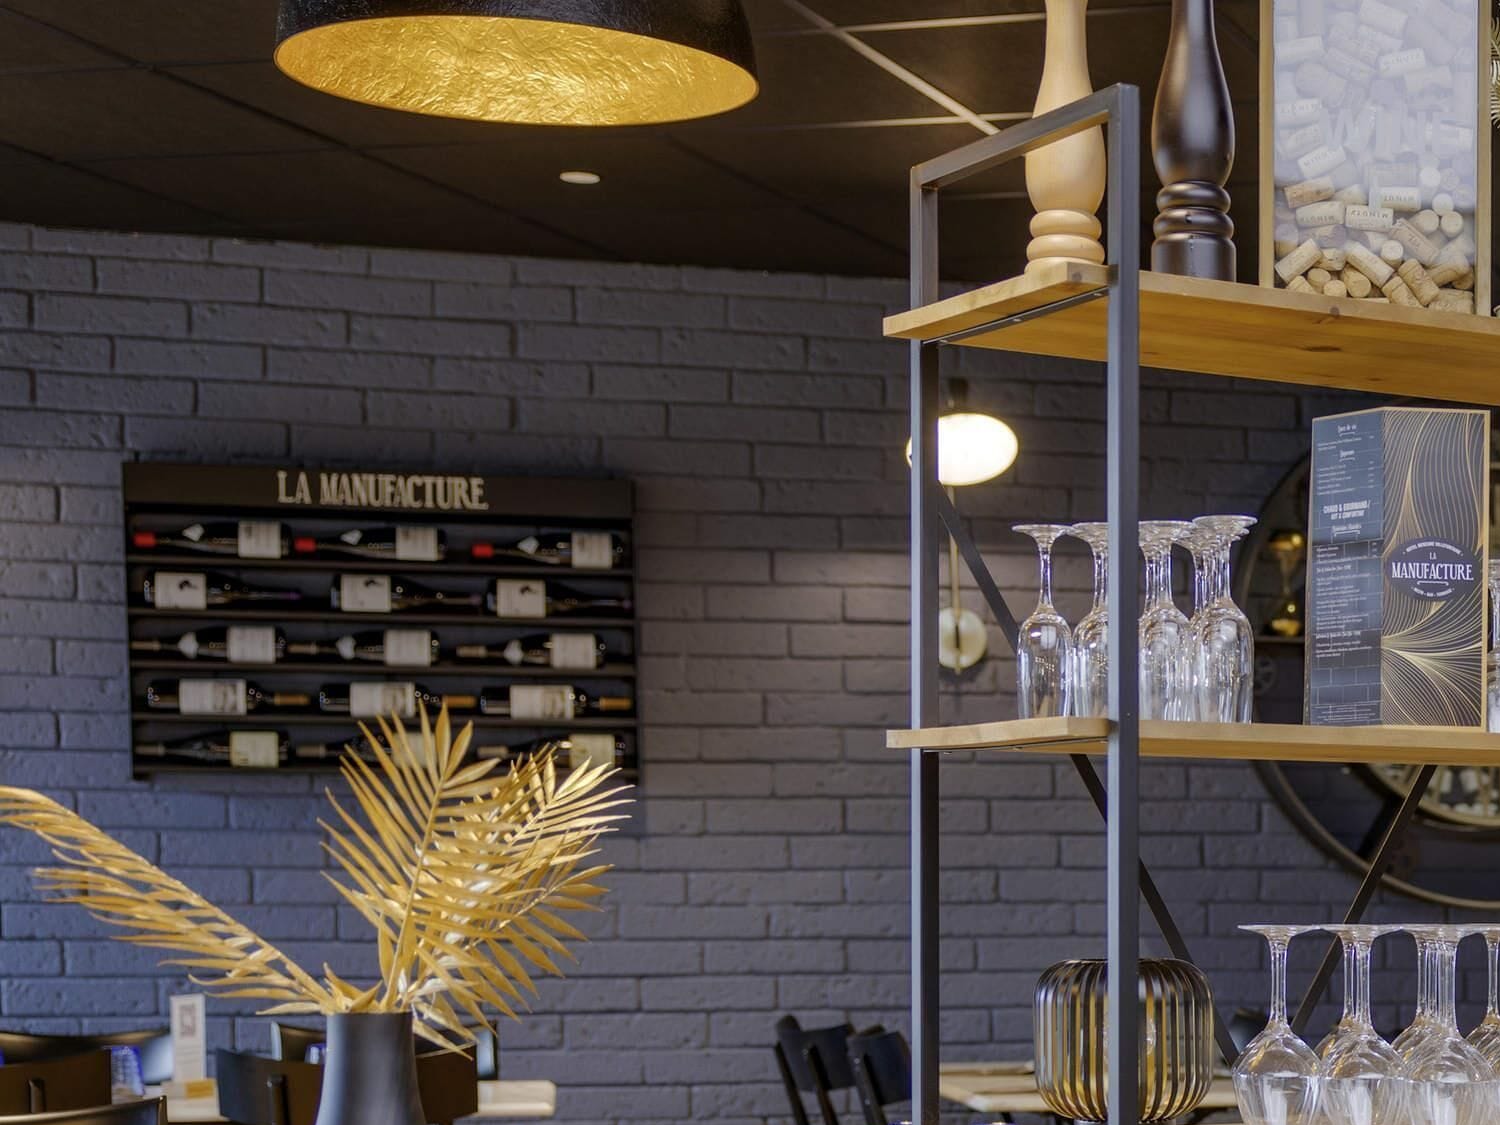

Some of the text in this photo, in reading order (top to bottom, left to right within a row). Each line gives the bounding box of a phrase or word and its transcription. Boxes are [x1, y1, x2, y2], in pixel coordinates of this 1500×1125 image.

[277, 470, 489, 511] LA MANUFACTURE
[1429, 551, 1437, 560] LA
[1392, 562, 1474, 580] MANUFACTURE
